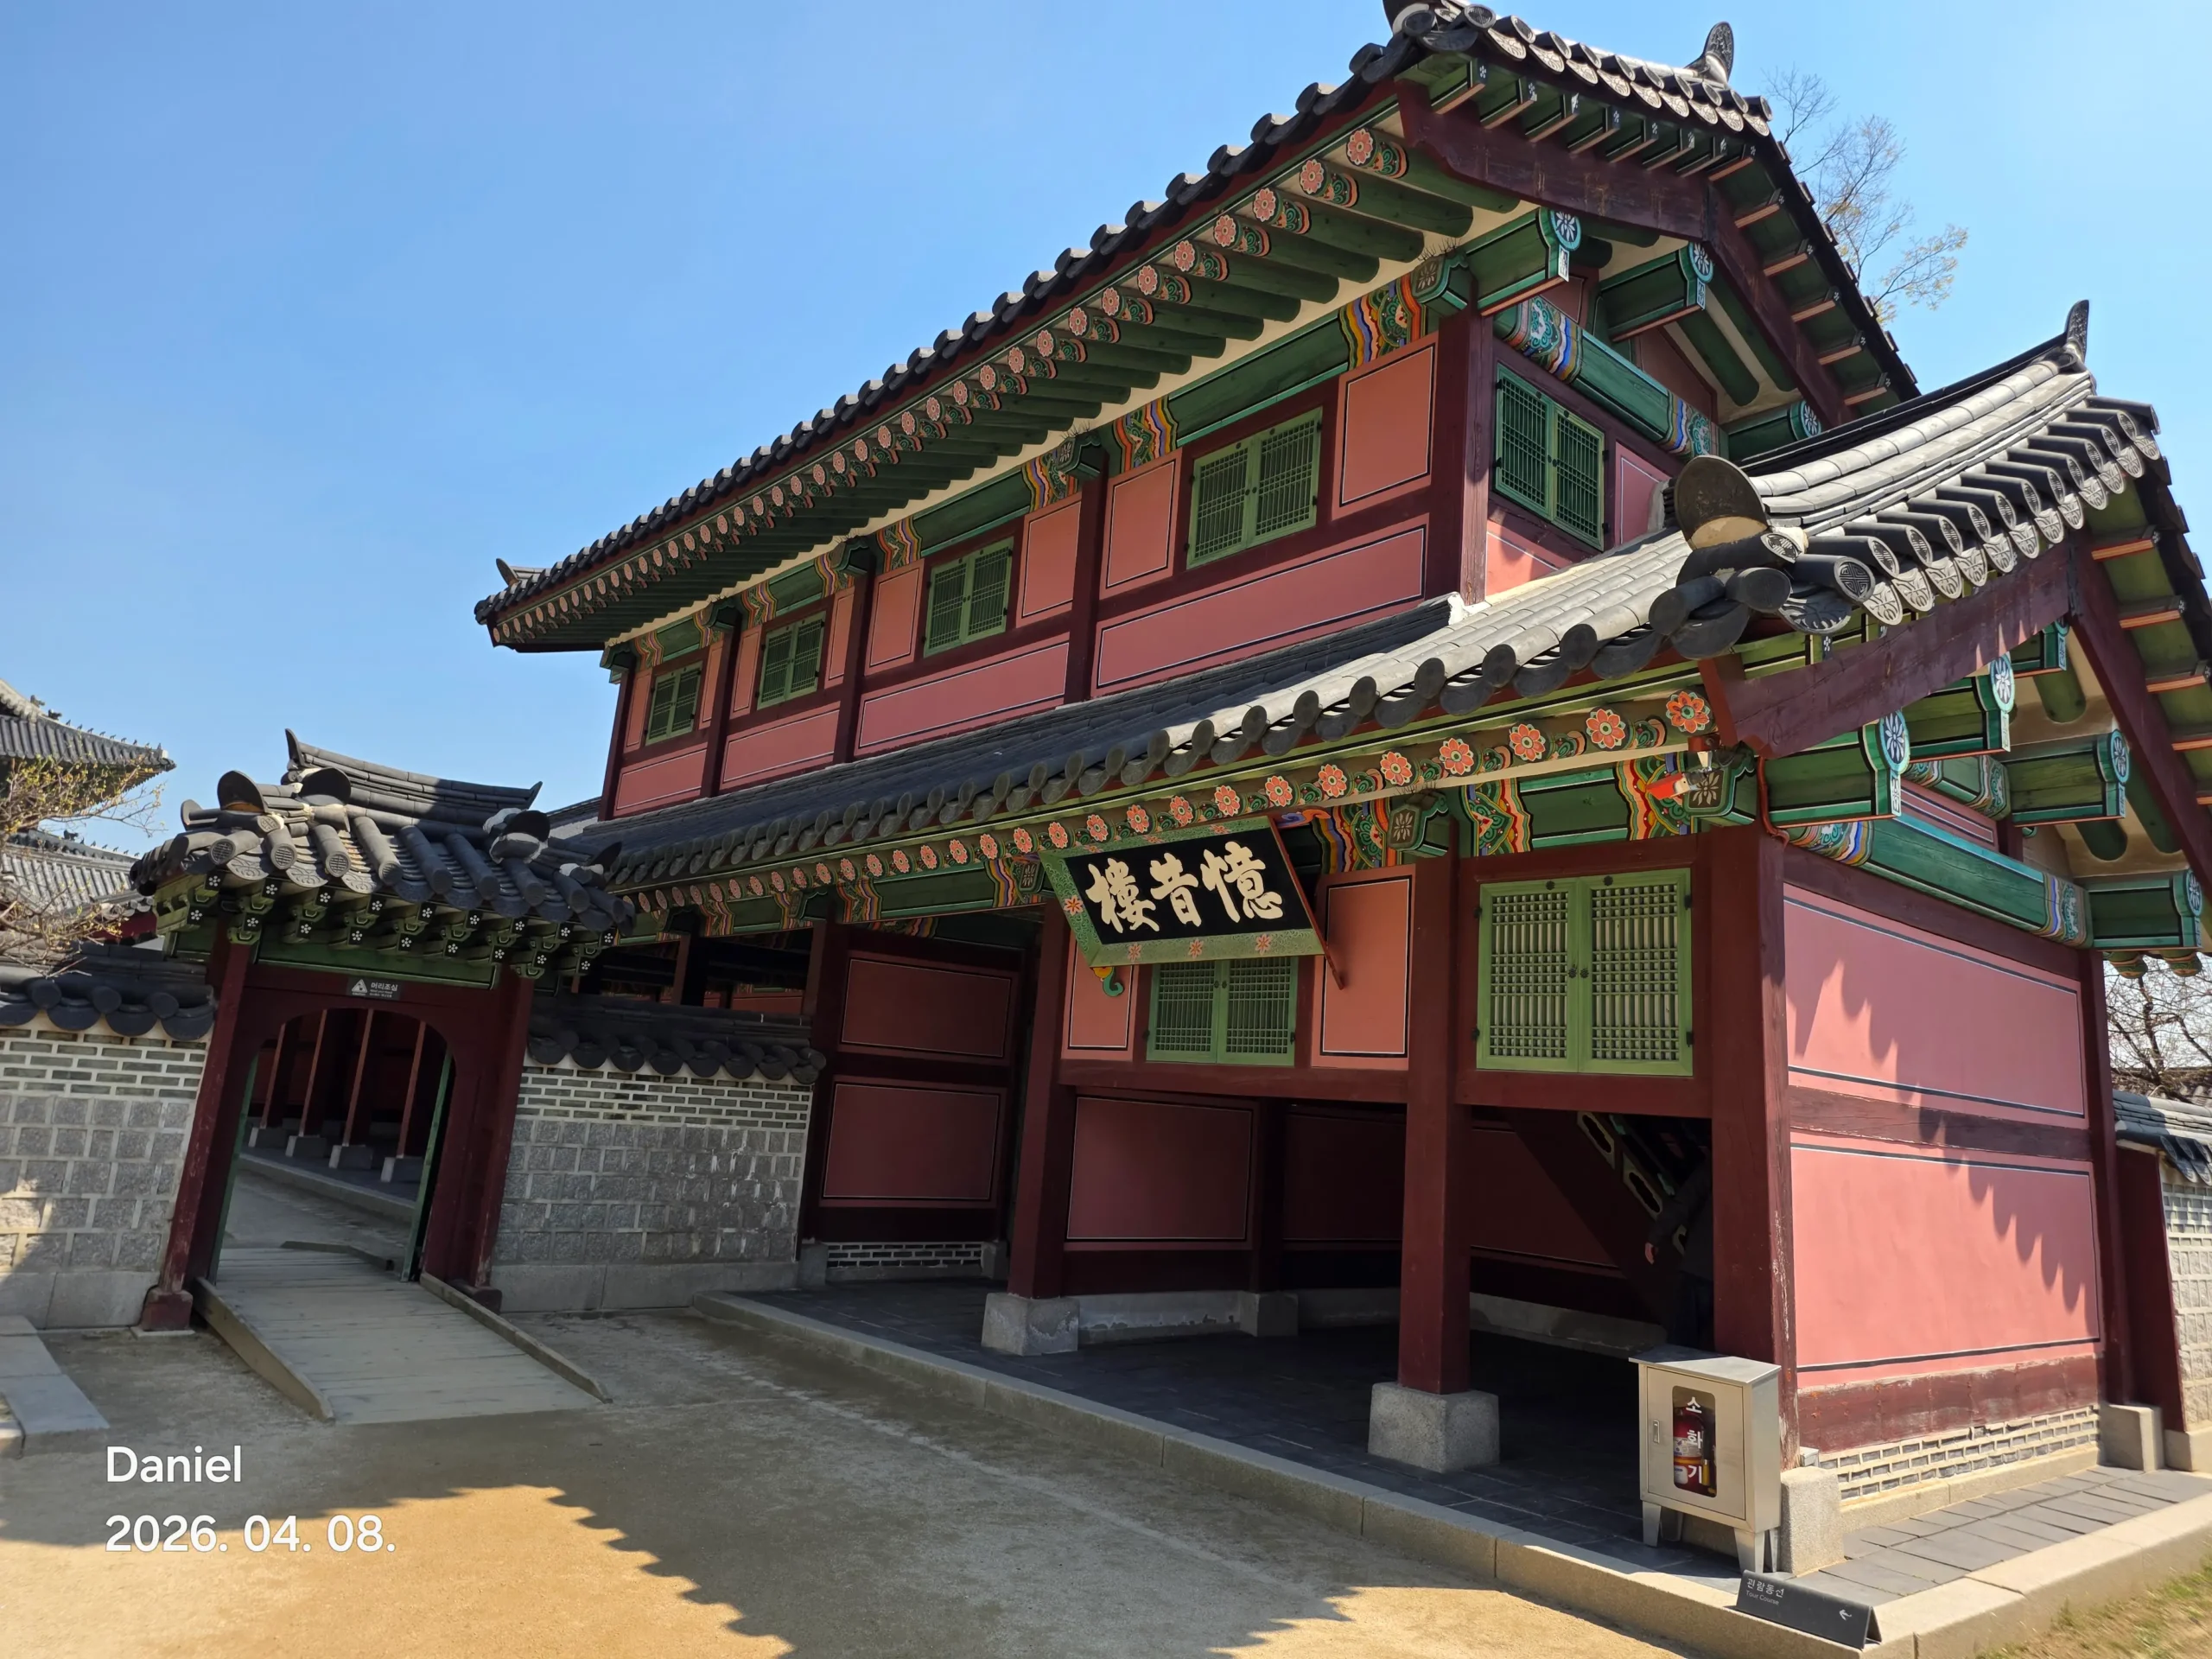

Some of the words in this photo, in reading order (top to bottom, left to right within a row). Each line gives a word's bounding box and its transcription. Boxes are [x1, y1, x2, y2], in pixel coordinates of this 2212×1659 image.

[371, 982, 398, 992] 머리조심
[1686, 1396, 1703, 1484] 소화기
[1745, 1590, 1759, 1599] Tour
[1759, 1594, 1780, 1605] Course
[1746, 1578, 1785, 1599] 관람동선
